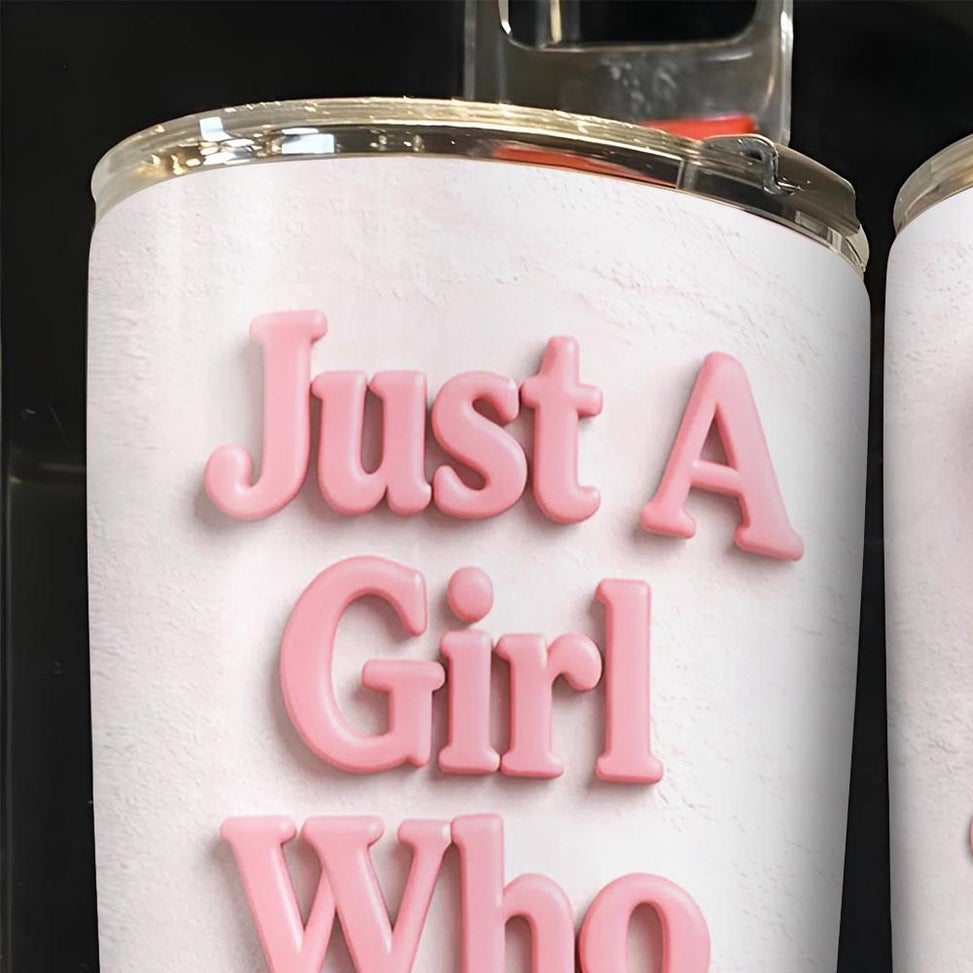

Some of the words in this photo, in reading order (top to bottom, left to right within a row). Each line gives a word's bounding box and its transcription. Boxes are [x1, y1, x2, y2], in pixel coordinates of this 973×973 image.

[203, 310, 603, 525] Just
[641, 352, 804, 561] A
[280, 556, 664, 785] Girl
